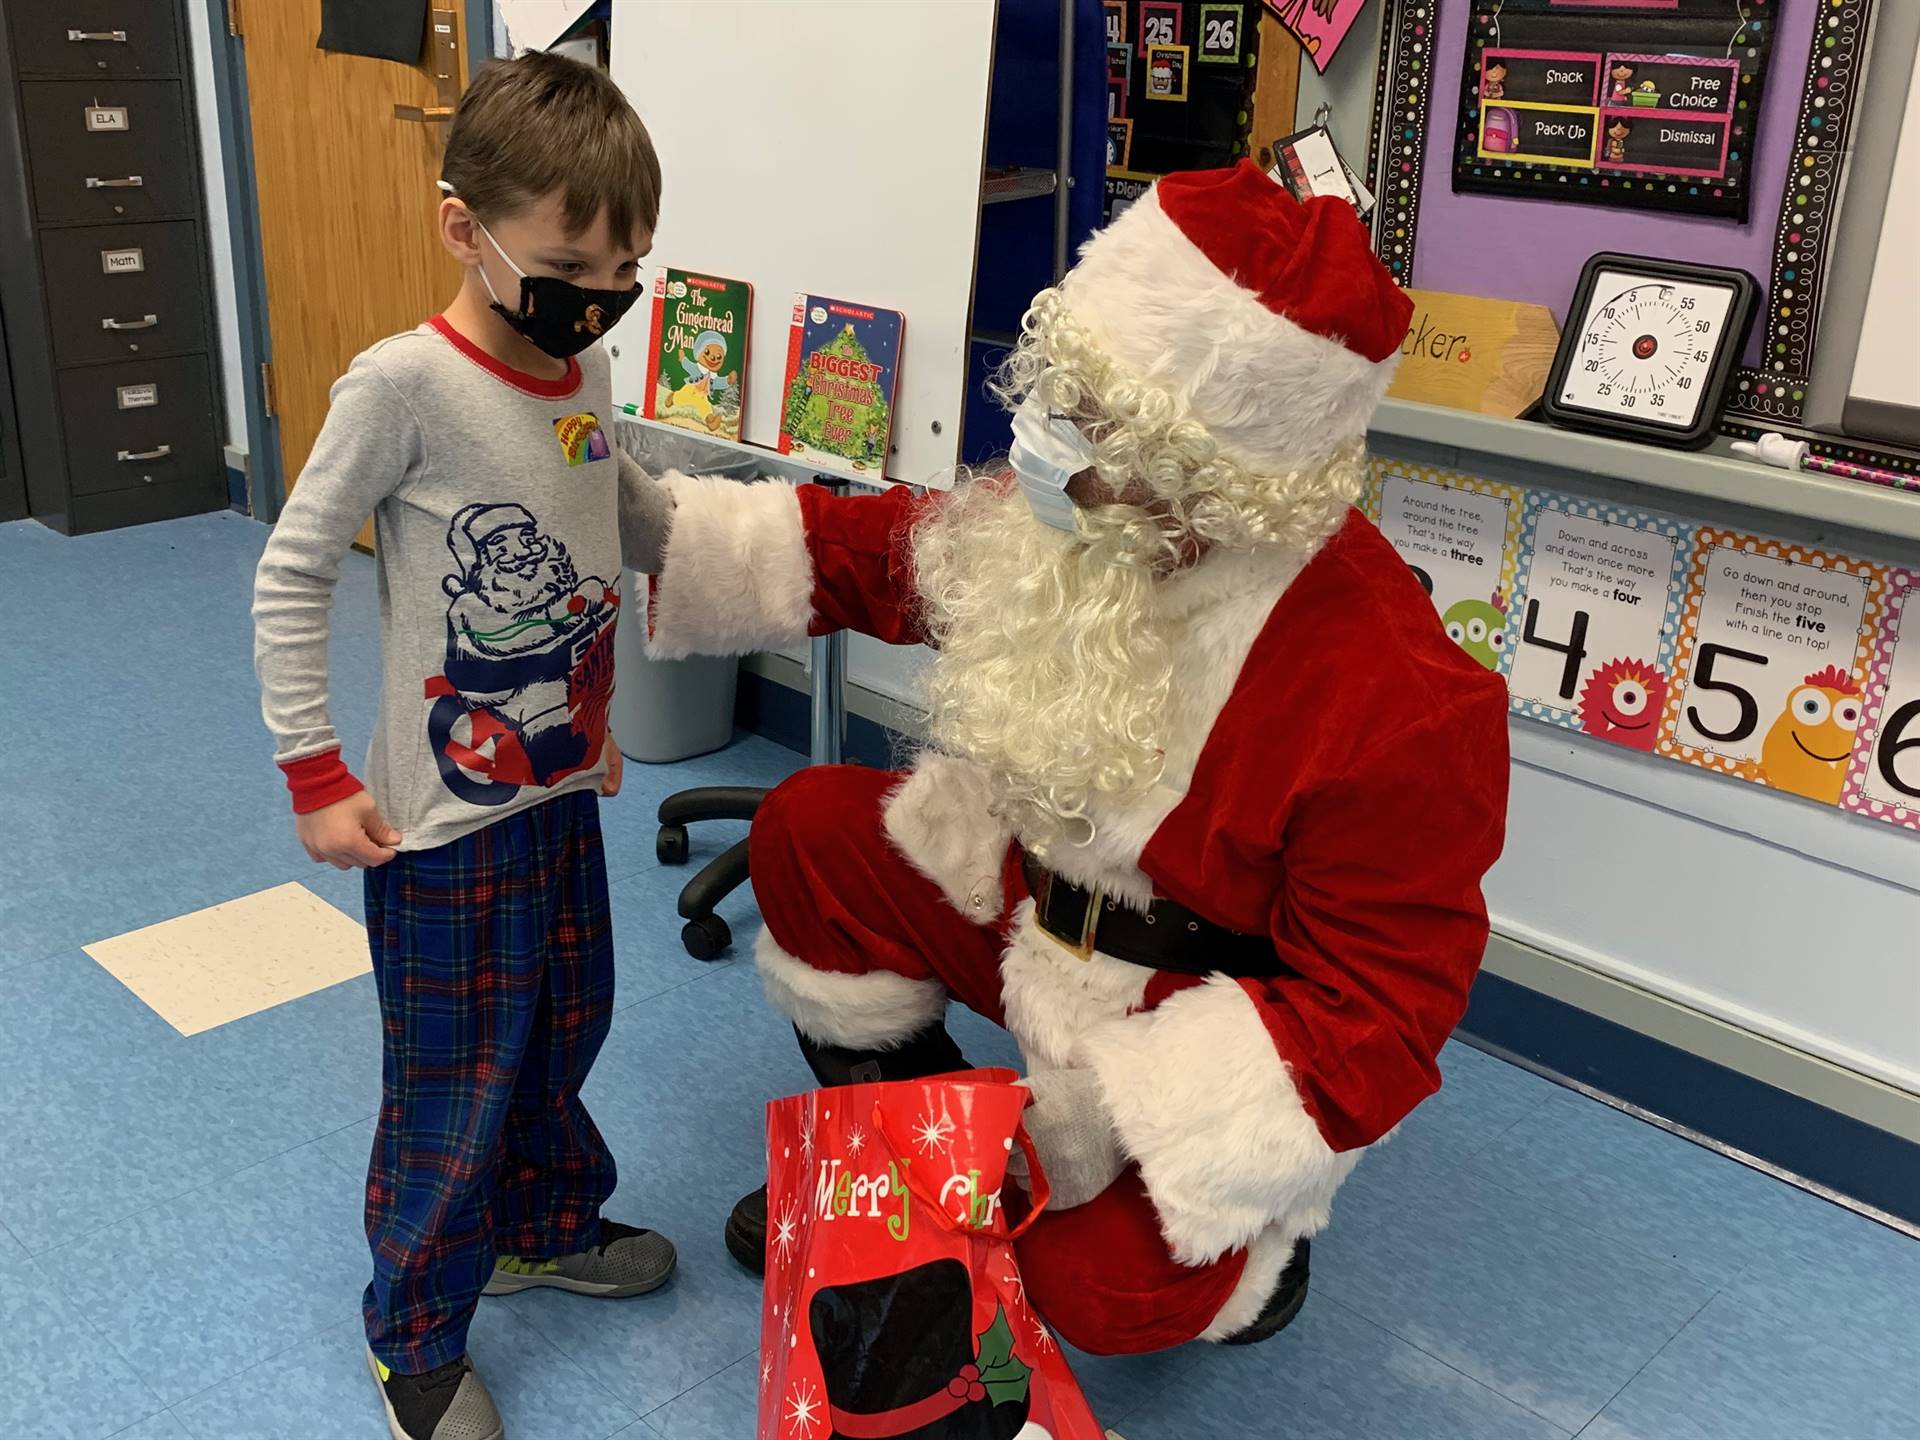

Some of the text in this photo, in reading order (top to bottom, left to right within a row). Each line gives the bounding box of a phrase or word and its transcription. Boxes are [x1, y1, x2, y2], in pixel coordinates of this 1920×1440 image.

[1145, 17, 1174, 45] 25
[1205, 19, 1234, 49] 26
[1546, 69, 1583, 85] Snack
[1690, 76, 1721, 91] Free
[1669, 93, 1718, 108] Choice
[96, 114, 116, 124] ELA
[1535, 122, 1586, 140] Pack Up
[1660, 129, 1715, 145] Dismissal
[110, 256, 136, 267] Math
[690, 288, 707, 307] The
[1629, 291, 1637, 303] 5
[1680, 297, 1696, 310] 55
[676, 302, 733, 334] Gingerbread
[835, 306, 874, 320] SCHOLASTIC
[1603, 308, 1615, 320] 10
[1695, 320, 1711, 333] 50
[664, 326, 695, 352] Man
[1586, 333, 1599, 345] 15
[1585, 360, 1599, 372] 20
[1693, 350, 1709, 363] 45
[812, 373, 875, 407] Christmas
[1597, 383, 1612, 396] 25
[1677, 377, 1692, 390] 40
[827, 400, 854, 424] Tree
[1620, 395, 1636, 408] 30
[1650, 393, 1665, 407] 35
[560, 416, 583, 446] Happy
[823, 420, 852, 443] Ever
[1402, 495, 1484, 523] Around the tree,
[1402, 511, 1479, 535] around the tree
[1408, 524, 1475, 551] That's the way
[1558, 529, 1648, 560] Down and across
[1394, 538, 1484, 566] you make a three
[1545, 544, 1655, 578] and down once more
[1562, 561, 1637, 591] That's the way
[1723, 566, 1850, 607] Go down and around,
[1549, 576, 1642, 606] you make a four
[1740, 587, 1822, 617] then you stop
[1735, 602, 1826, 633] Finish the five
[1726, 619, 1830, 652] with a line on top!
[1523, 598, 1590, 700] 4
[1687, 643, 1769, 743] 5
[1877, 698, 1920, 798] 6
[814, 1158, 911, 1242] Merry
